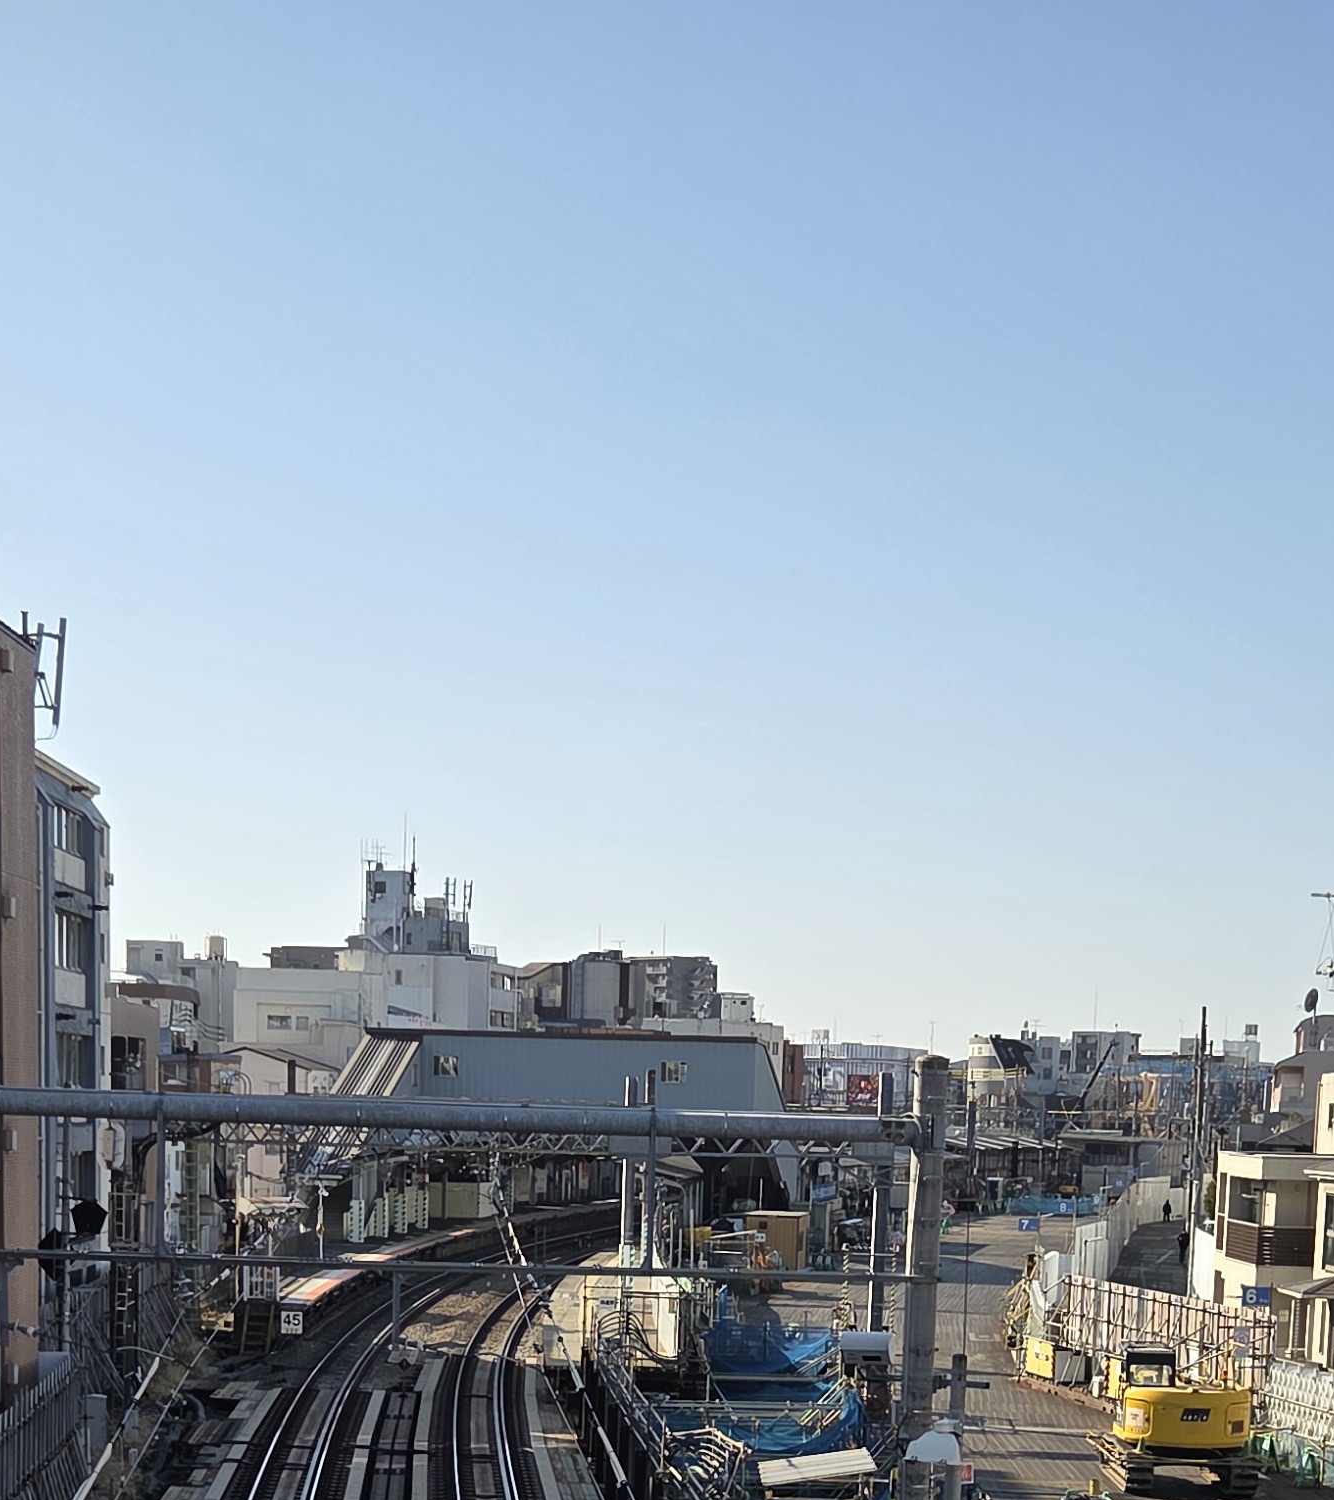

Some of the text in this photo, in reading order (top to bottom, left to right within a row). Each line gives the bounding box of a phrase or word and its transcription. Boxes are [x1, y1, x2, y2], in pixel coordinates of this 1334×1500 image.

[1059, 1202, 1067, 1213] 8
[1021, 1219, 1029, 1231] 7
[1246, 1288, 1257, 1304] 6
[283, 1313, 301, 1326] 45
